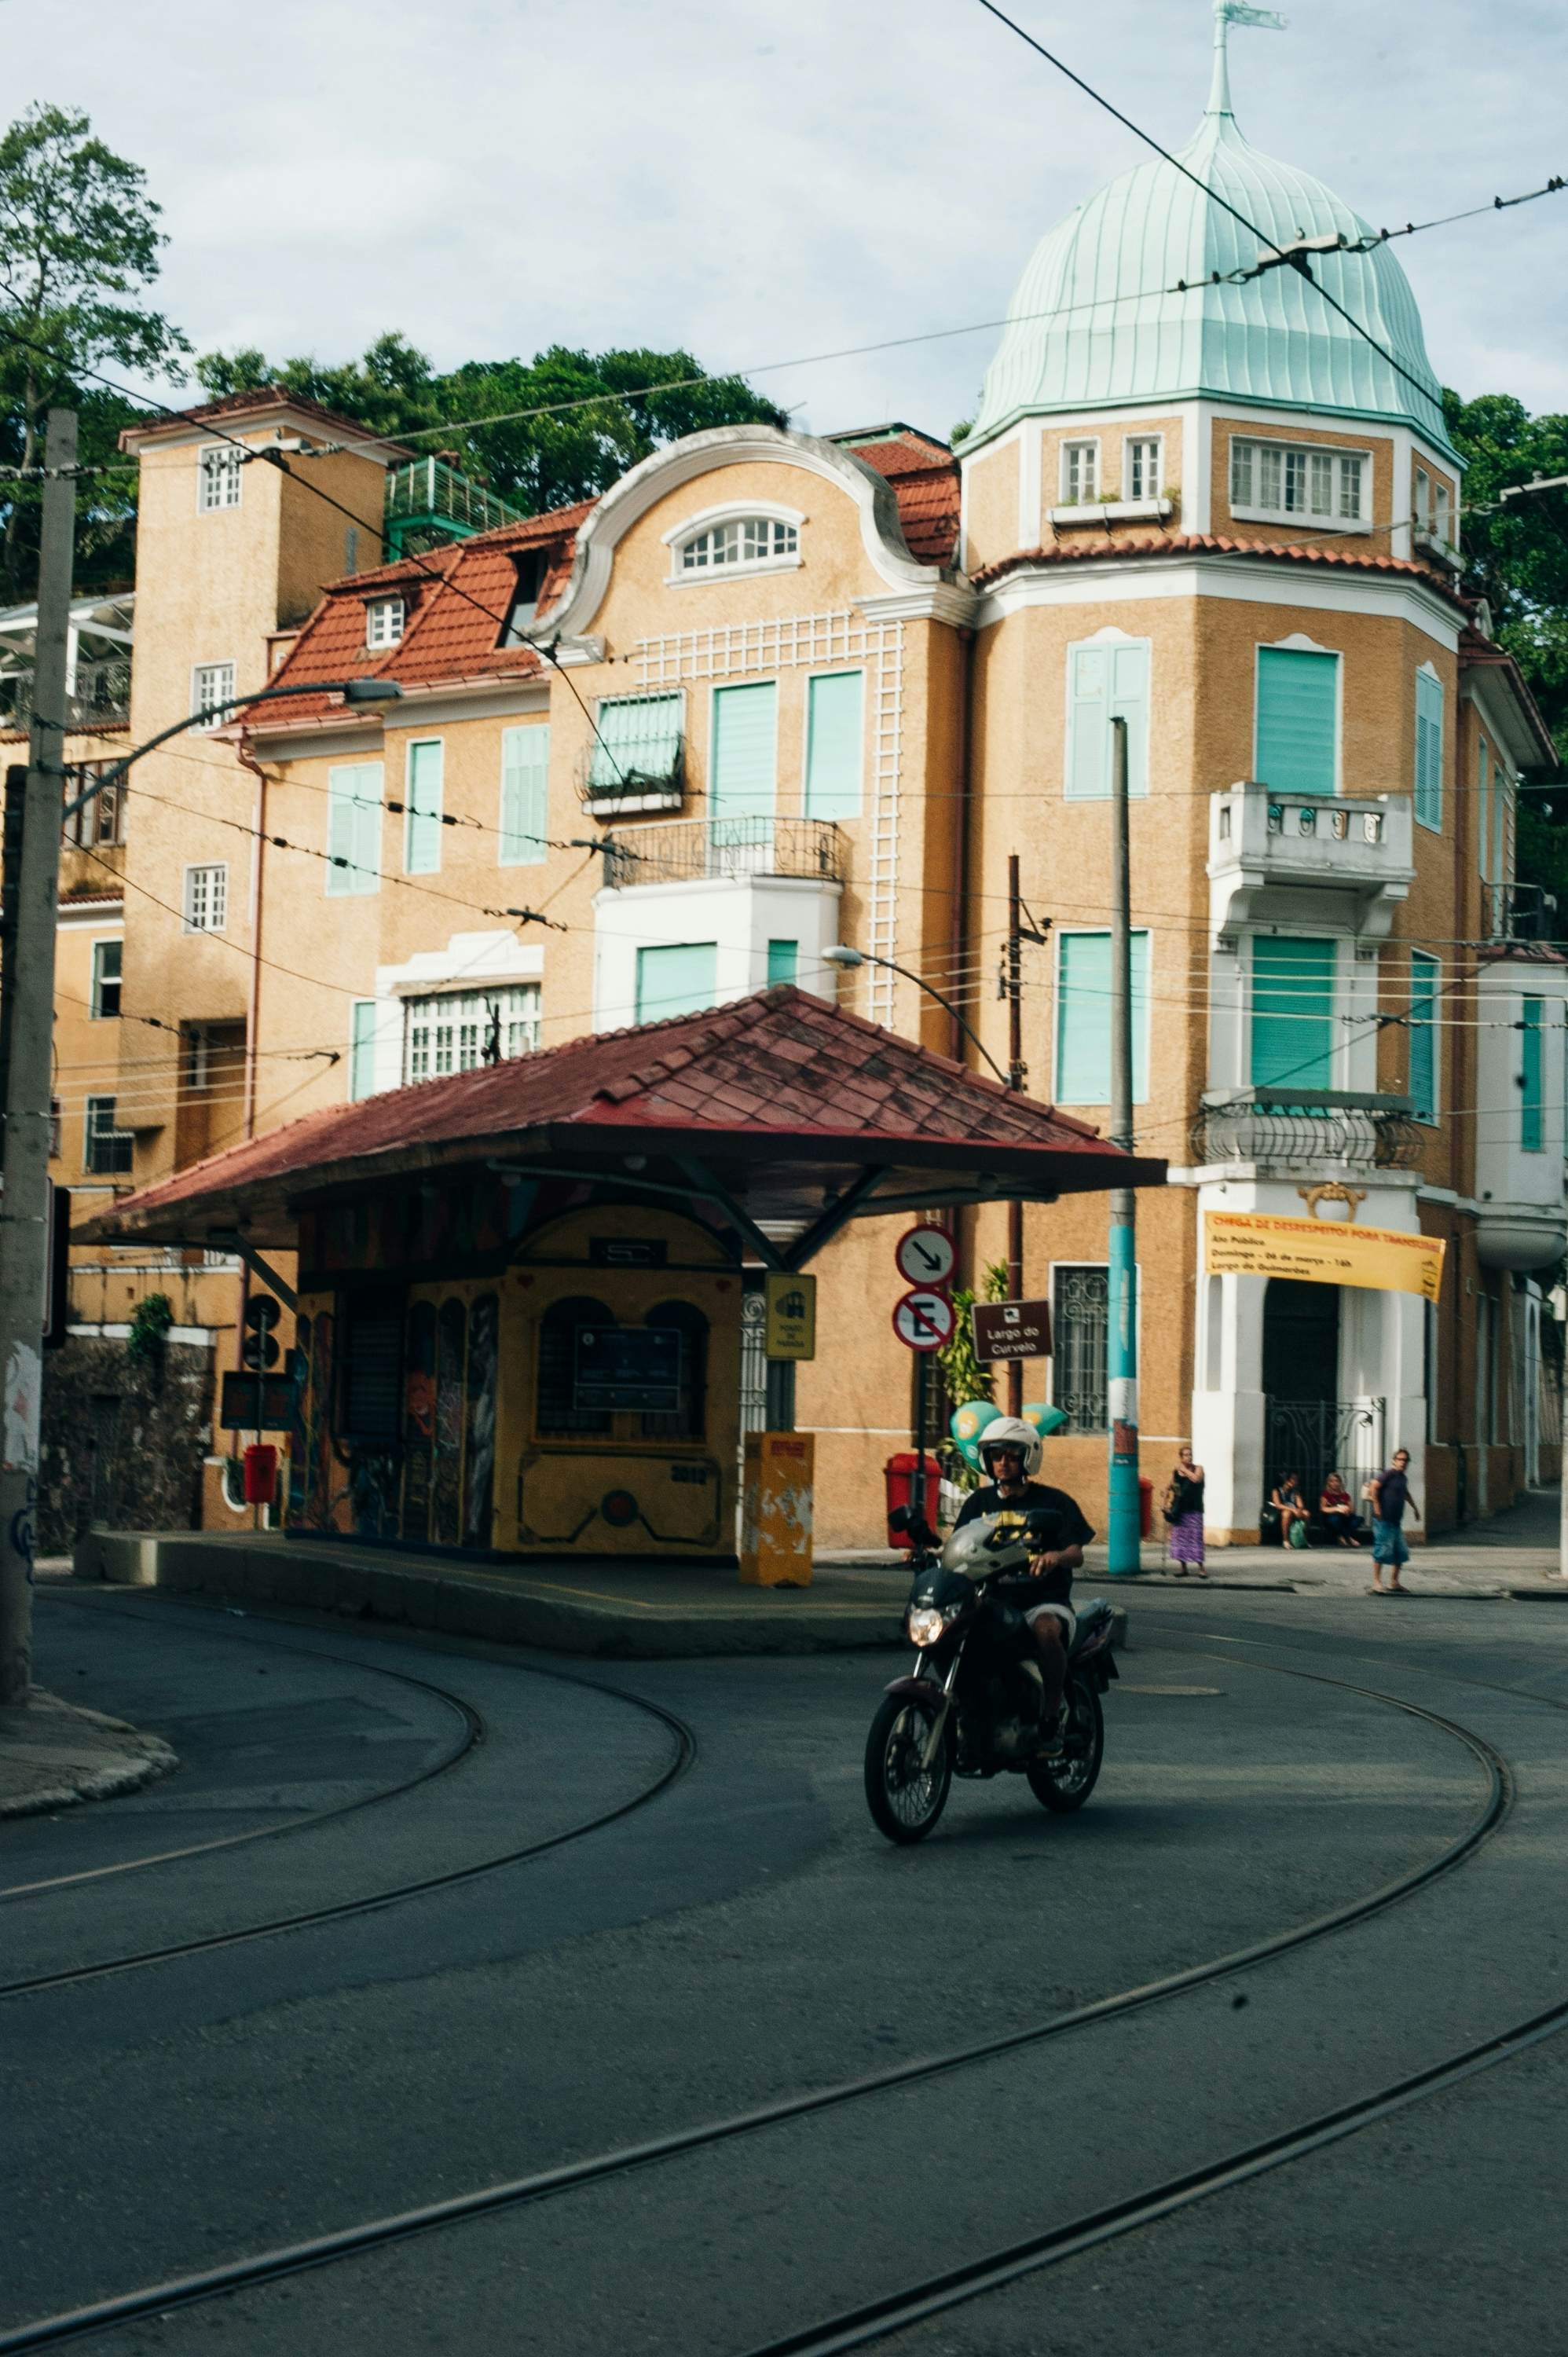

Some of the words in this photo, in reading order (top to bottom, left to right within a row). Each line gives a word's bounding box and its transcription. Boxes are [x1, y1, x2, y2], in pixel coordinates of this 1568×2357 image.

[914, 1301, 936, 1337] E
[987, 1329, 1022, 1340] Largo
[1023, 1326, 1040, 1337] do
[991, 1341, 1038, 1355] Curvelo
